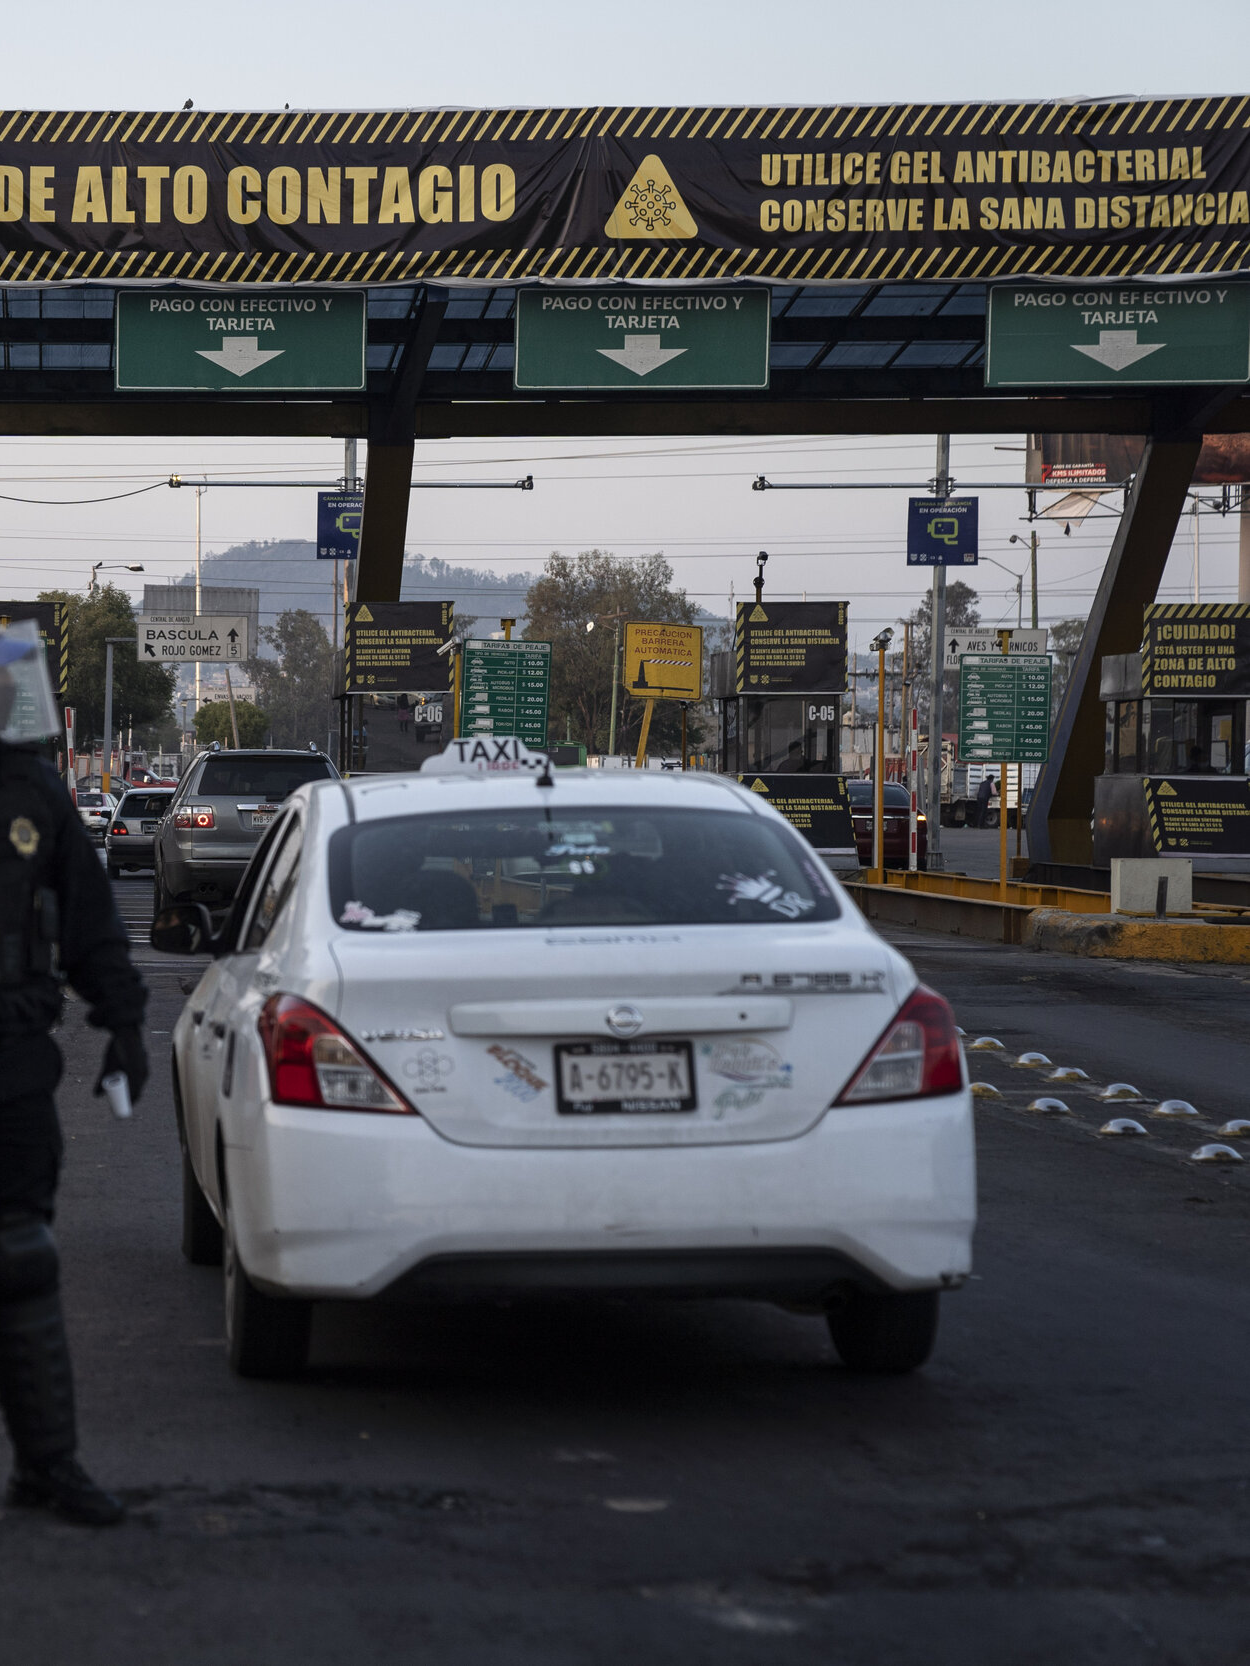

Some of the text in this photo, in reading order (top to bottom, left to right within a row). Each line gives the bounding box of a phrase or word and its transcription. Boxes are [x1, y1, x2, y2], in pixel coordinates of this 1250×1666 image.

[762, 147, 1207, 188] UTILICE GEL ANTIBACTERIAL
[71, 166, 207, 224] ALTO
[228, 164, 515, 224] CONTAGIO
[760, 191, 1250, 232] CONSERVE LA SANA DISTANCIA
[542, 296, 743, 311] PAGO CON EFECTIVO Y
[1014, 290, 1227, 306] PAGO CON EFECTIVO Y
[150, 299, 332, 312] PAGO CON EFECTIVO Y
[605, 315, 680, 328] TARJETA
[1081, 310, 1158, 325] TARJETA
[206, 318, 275, 331] TARJETA
[1068, 468, 1106, 476] ILIMITADOS
[146, 629, 219, 640] BASCULA
[635, 628, 692, 639] PRECAUCION
[1157, 624, 1236, 641] ¡CUIDADO!
[641, 638, 685, 647] BARRERA
[967, 641, 1038, 651] AVES Y RNICOS
[162, 645, 221, 656] ROJO GOMEZ
[230, 646, 237, 655] 5
[634, 646, 693, 657] AUTOMATICA
[1154, 644, 1235, 655] ESTÁ USTED EN UNA
[1154, 657, 1236, 670] ZONA DE ALTO
[1154, 674, 1217, 688] CONTAGIO
[414, 705, 442, 722] C-06
[808, 705, 835, 721] C-05
[454, 740, 519, 763] TAXI
[569, 1061, 684, 1092] A-6795-K
